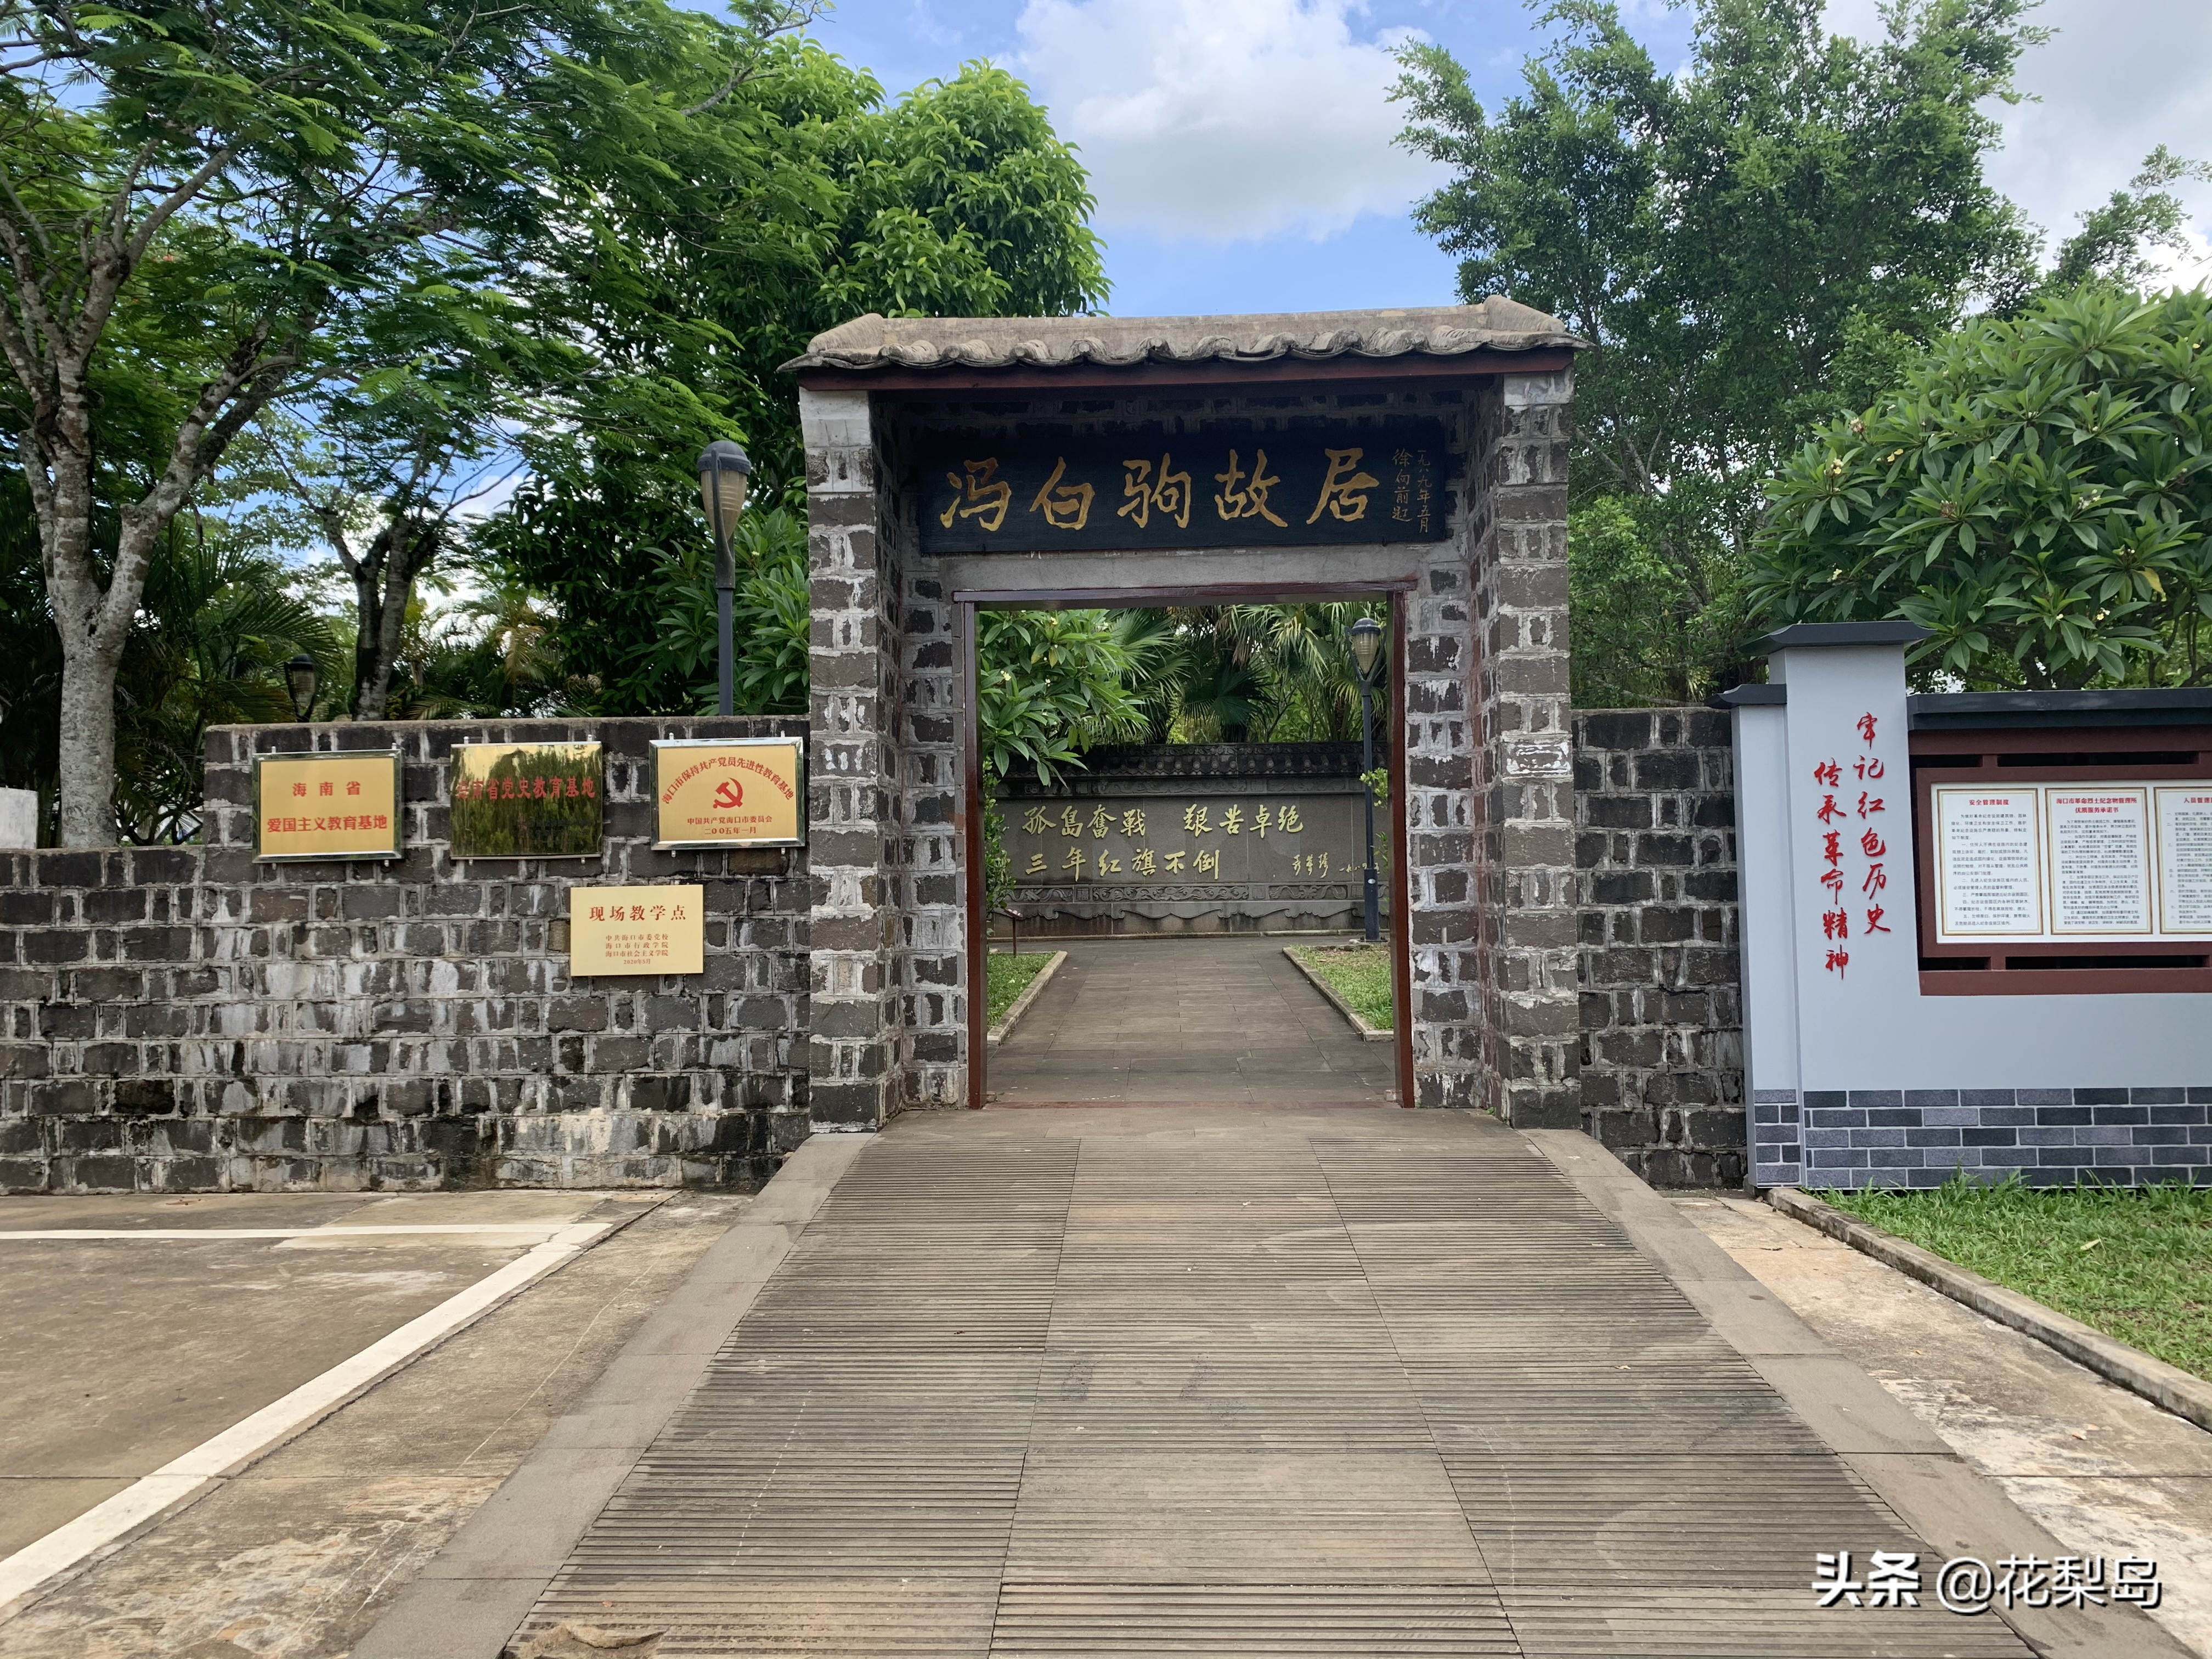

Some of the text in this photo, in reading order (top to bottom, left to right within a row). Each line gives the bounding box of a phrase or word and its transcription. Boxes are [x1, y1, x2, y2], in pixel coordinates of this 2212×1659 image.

[940, 448, 1380, 531] 冯白驹故居
[456, 776, 595, 800] 海南省党史教育基地
[662, 756, 794, 804] 海口市保持共产党员先进性教育基地
[292, 781, 361, 797] 海南省
[267, 815, 387, 832] 爱国主义教育基地
[687, 815, 772, 825] 中国共产党海口市委员会
[1853, 712, 1891, 934] 牢记红色历史
[1814, 758, 1849, 980] 传承革命精神
[589, 905, 686, 922] 现场教学点
[606, 933, 669, 941] 中共海口市委党校
[606, 941, 669, 950] 海口市行政学院
[605, 950, 669, 958] 海口市社会主义学院
